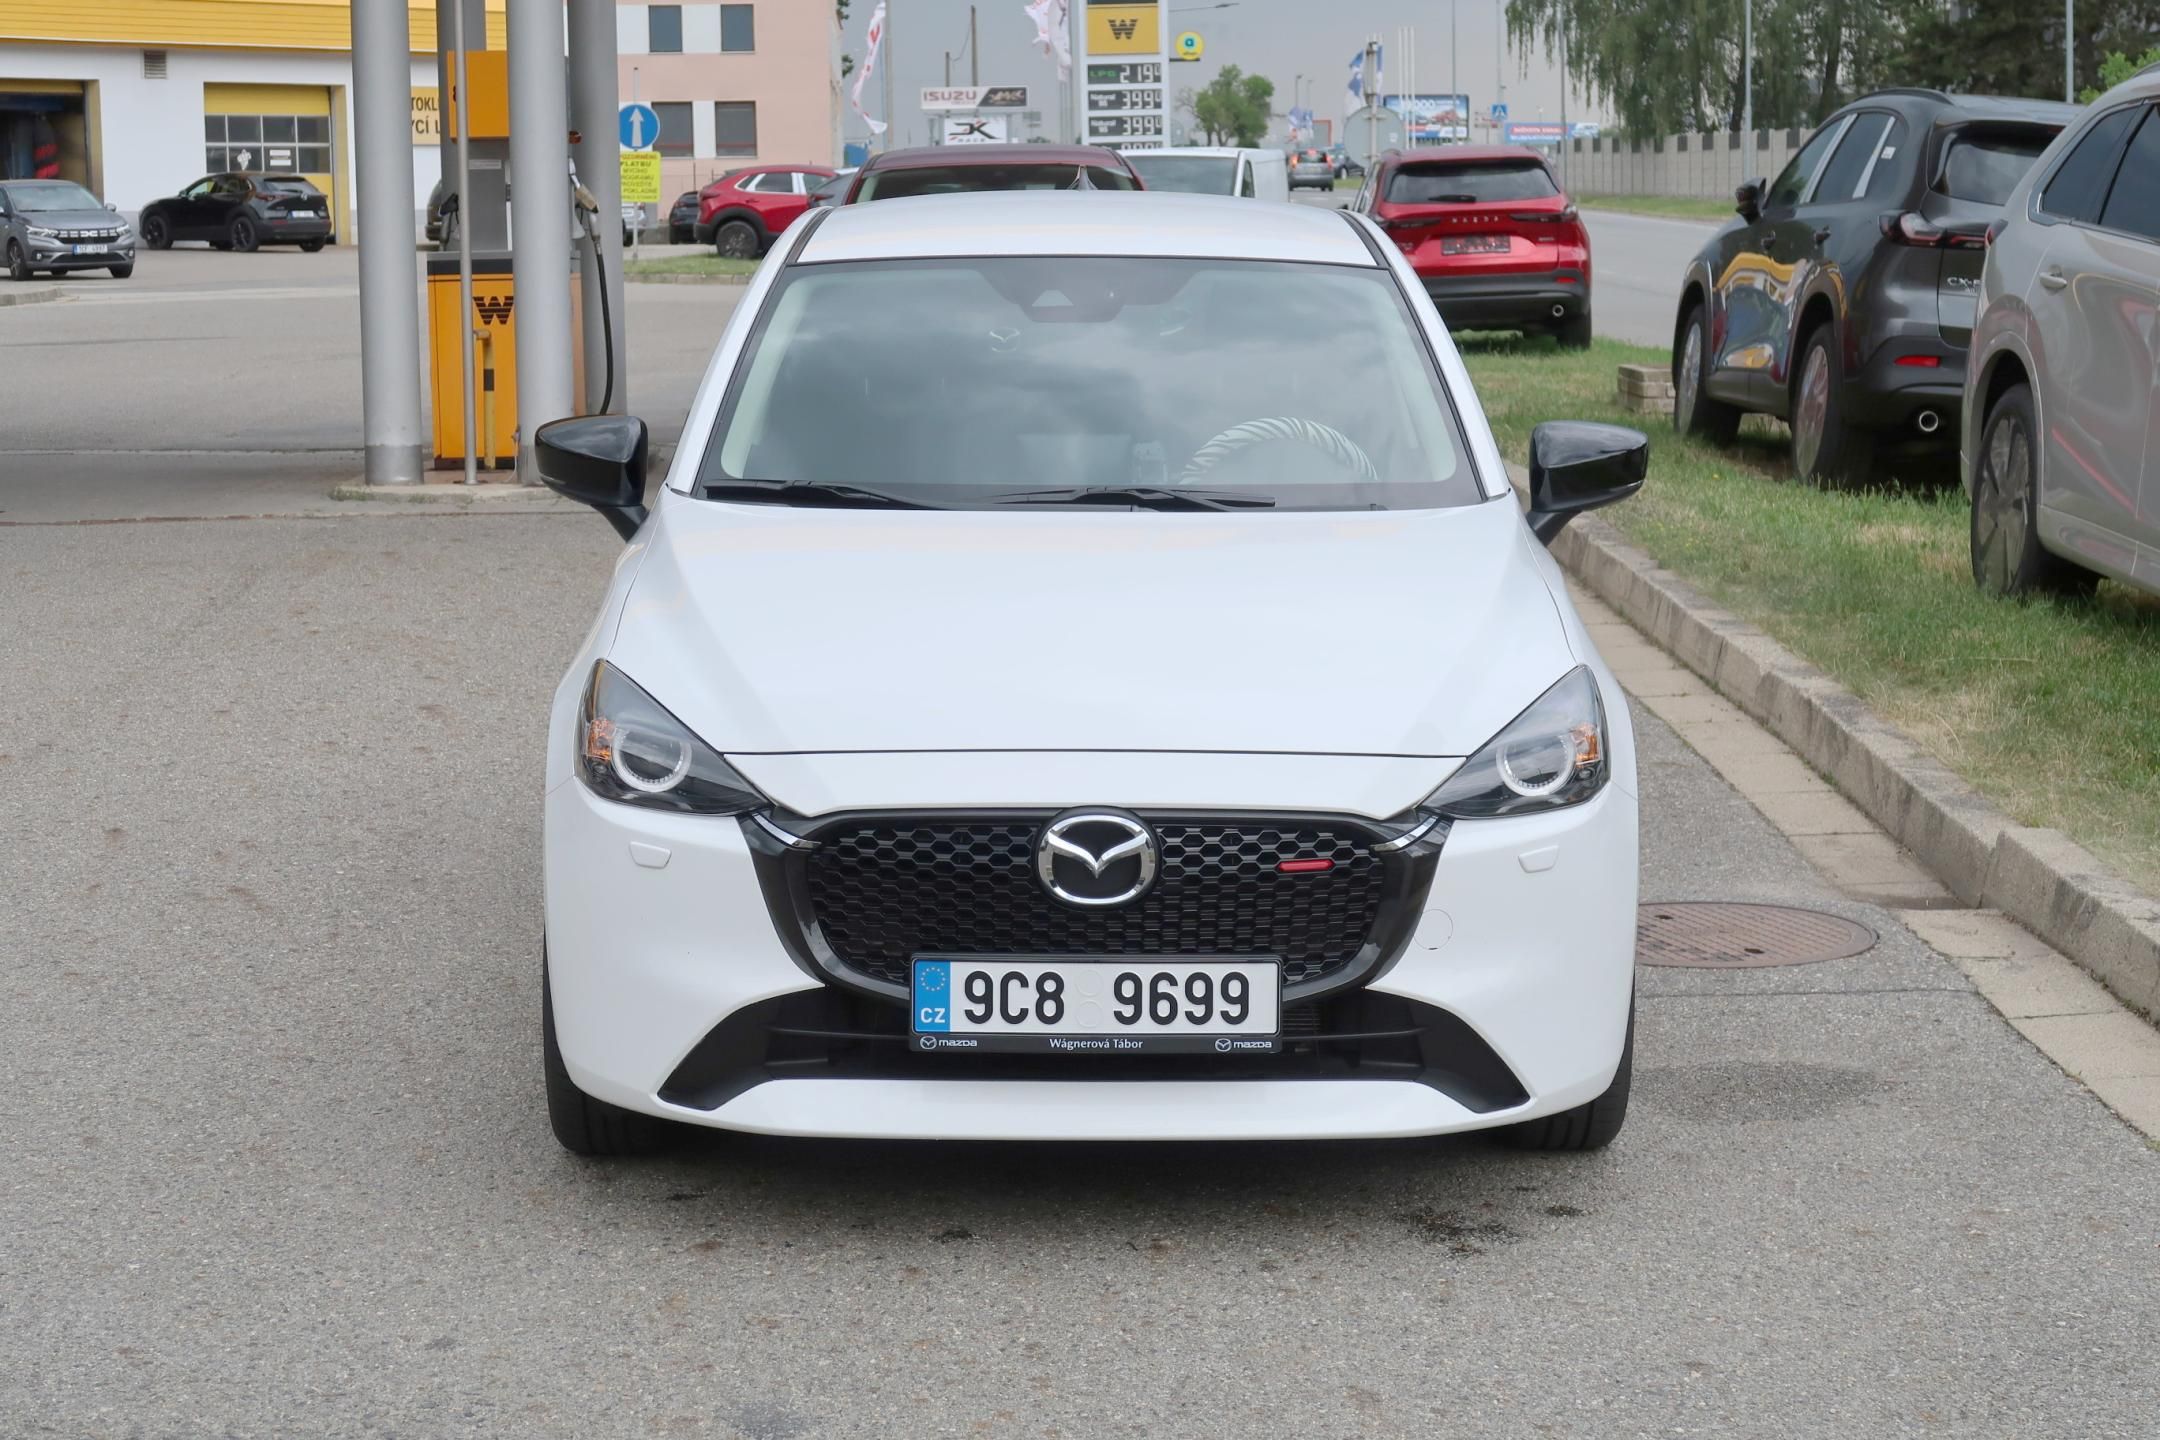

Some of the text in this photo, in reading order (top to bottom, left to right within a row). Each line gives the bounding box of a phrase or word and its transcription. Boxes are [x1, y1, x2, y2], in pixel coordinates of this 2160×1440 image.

[923, 90, 977, 101] ISUZU
[1452, 216, 1499, 224] MAZDA
[964, 970, 1250, 1026] 9C8 9699
[920, 1007, 946, 1024] CZ
[938, 1039, 978, 1048] mazda
[1049, 1037, 1144, 1051] Wágnerová Tábor
[1233, 1040, 1273, 1049] mazda
